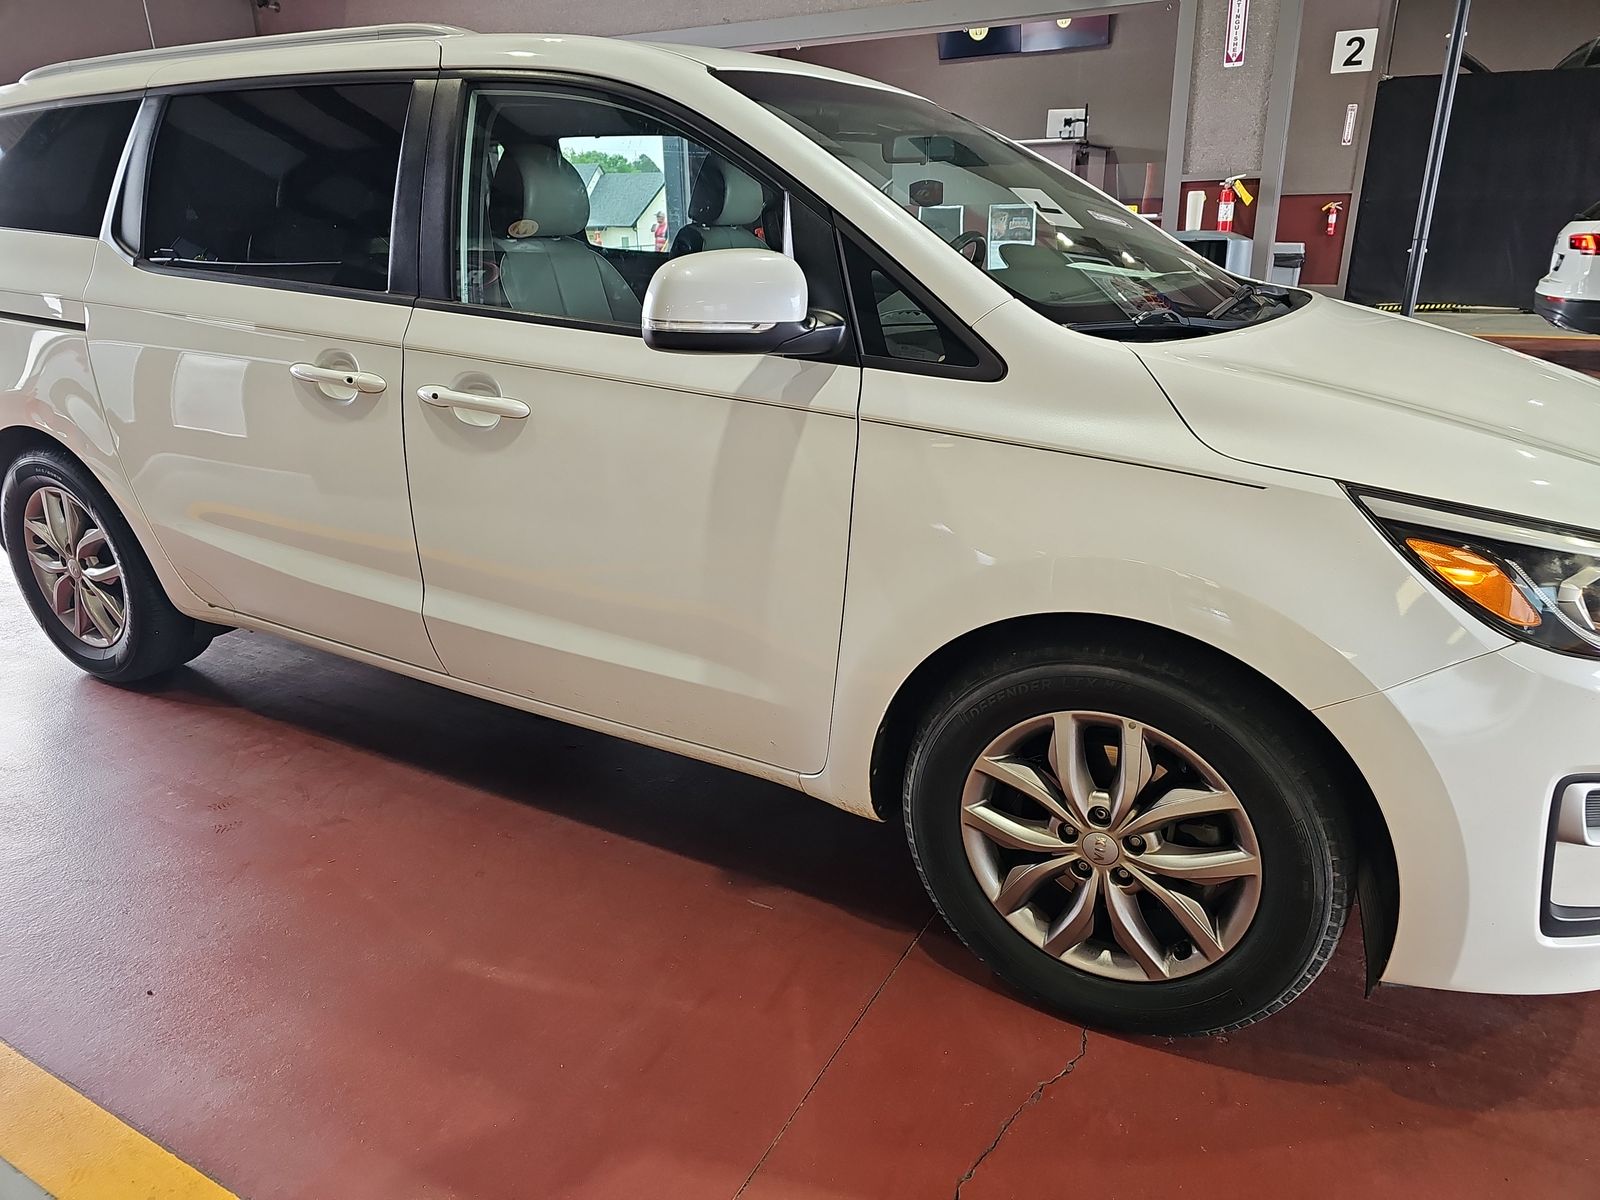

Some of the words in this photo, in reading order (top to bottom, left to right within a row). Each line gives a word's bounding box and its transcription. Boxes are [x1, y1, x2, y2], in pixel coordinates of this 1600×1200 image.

[1342, 36, 1365, 66] 2
[966, 680, 1053, 720] DEFENDER
[1094, 836, 1107, 861] KIA
